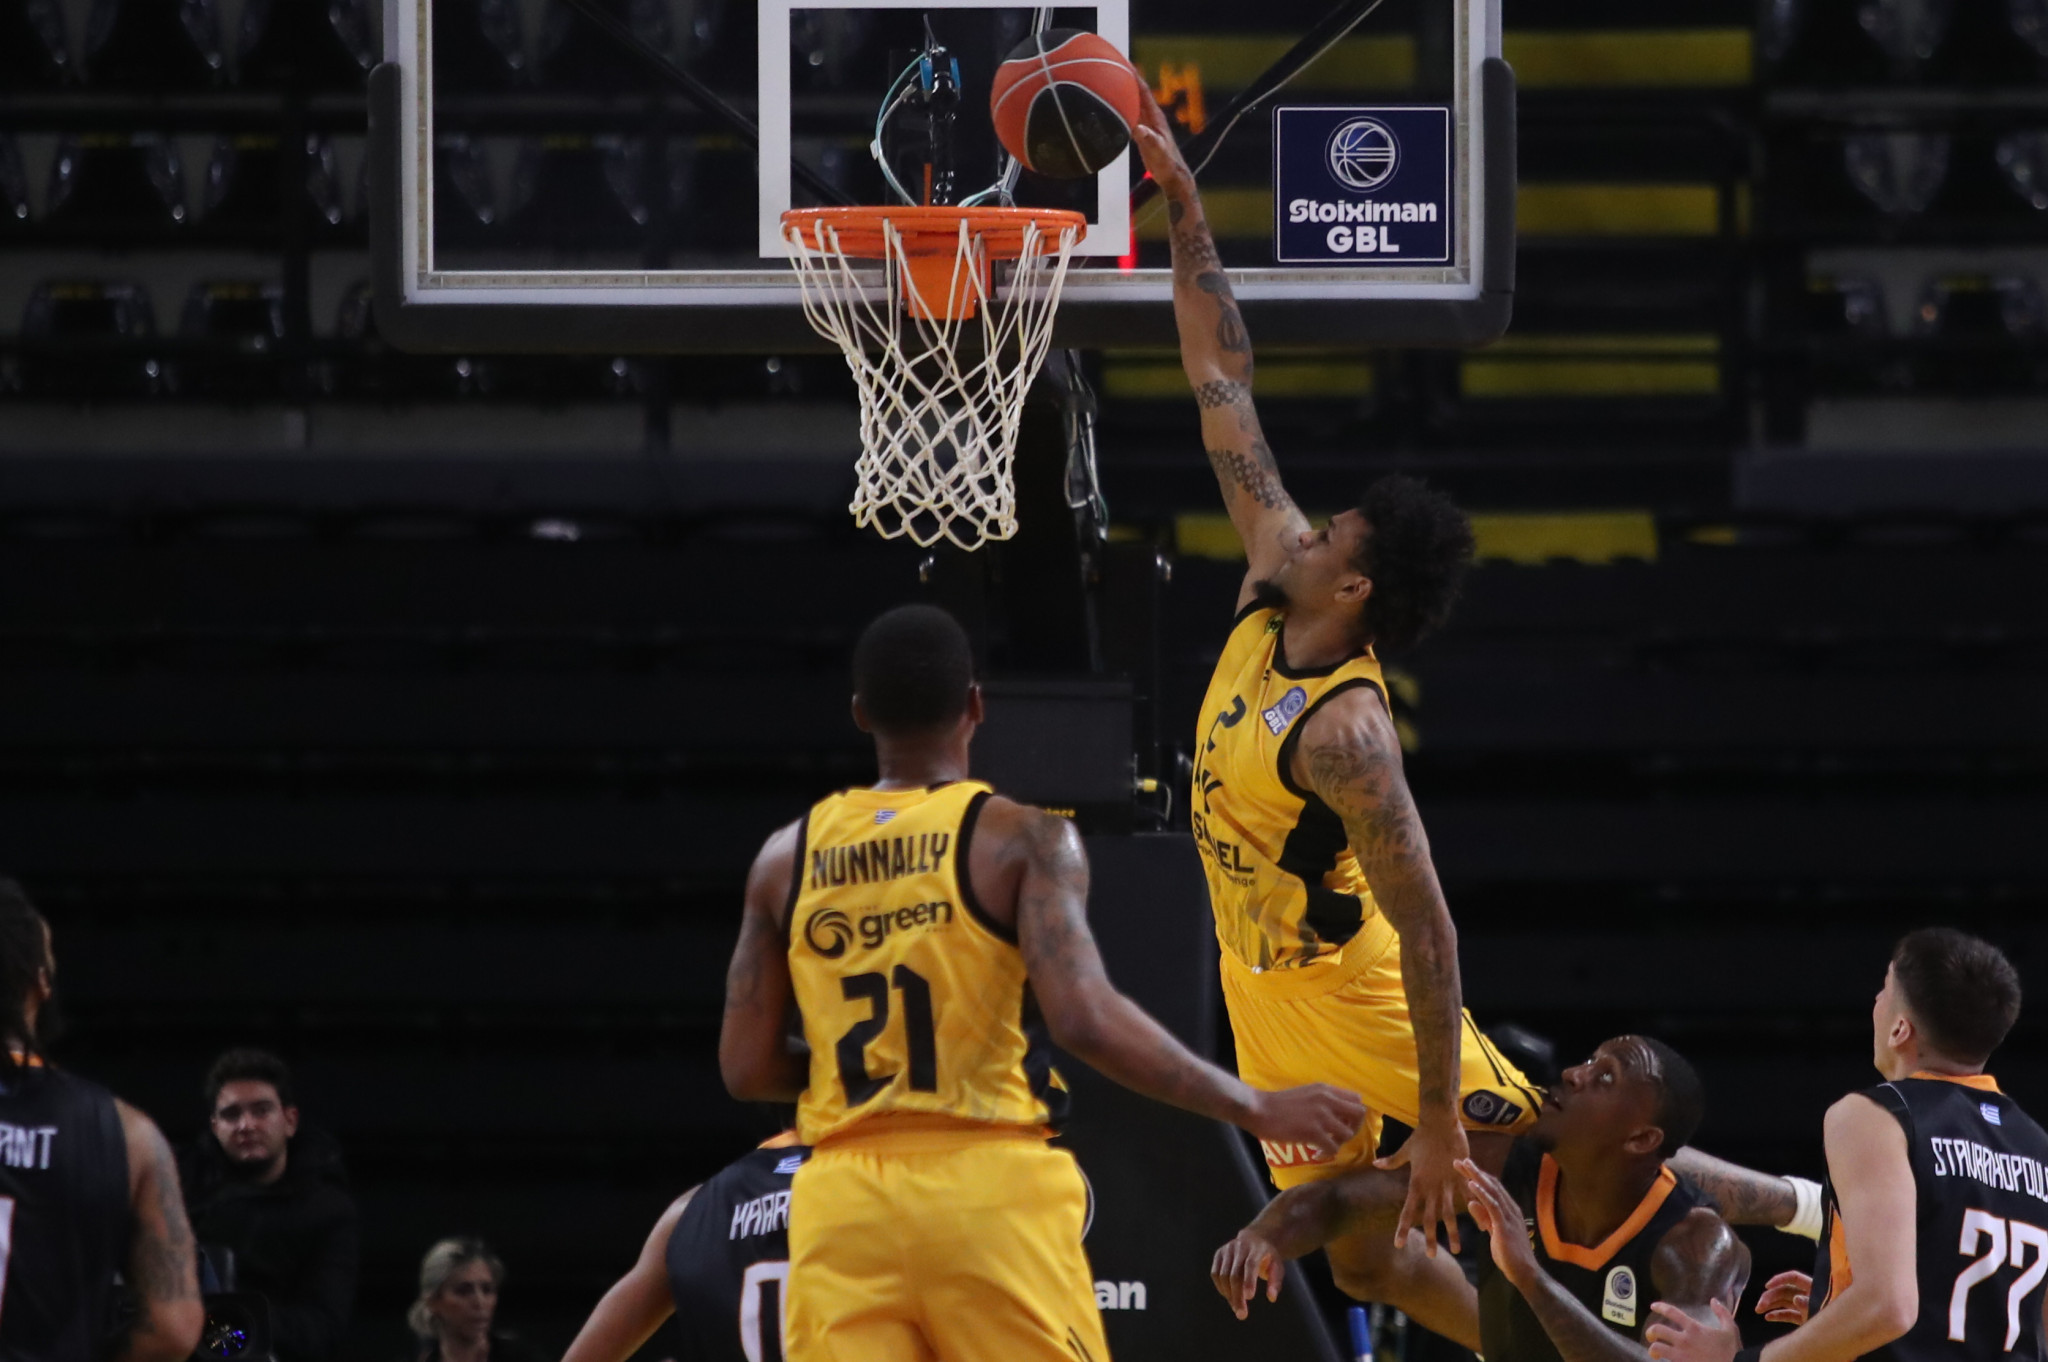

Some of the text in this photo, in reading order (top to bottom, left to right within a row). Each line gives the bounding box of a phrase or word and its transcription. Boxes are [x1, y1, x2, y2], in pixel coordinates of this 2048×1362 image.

[1289, 199, 1437, 223] Stoiximan
[1326, 226, 1399, 253] GBL
[1265, 710, 1282, 734] GBL
[811, 832, 950, 890] NUNNALLY
[858, 901, 952, 950] green
[835, 964, 938, 1109] 21
[1947, 1207, 2048, 1352] 77
